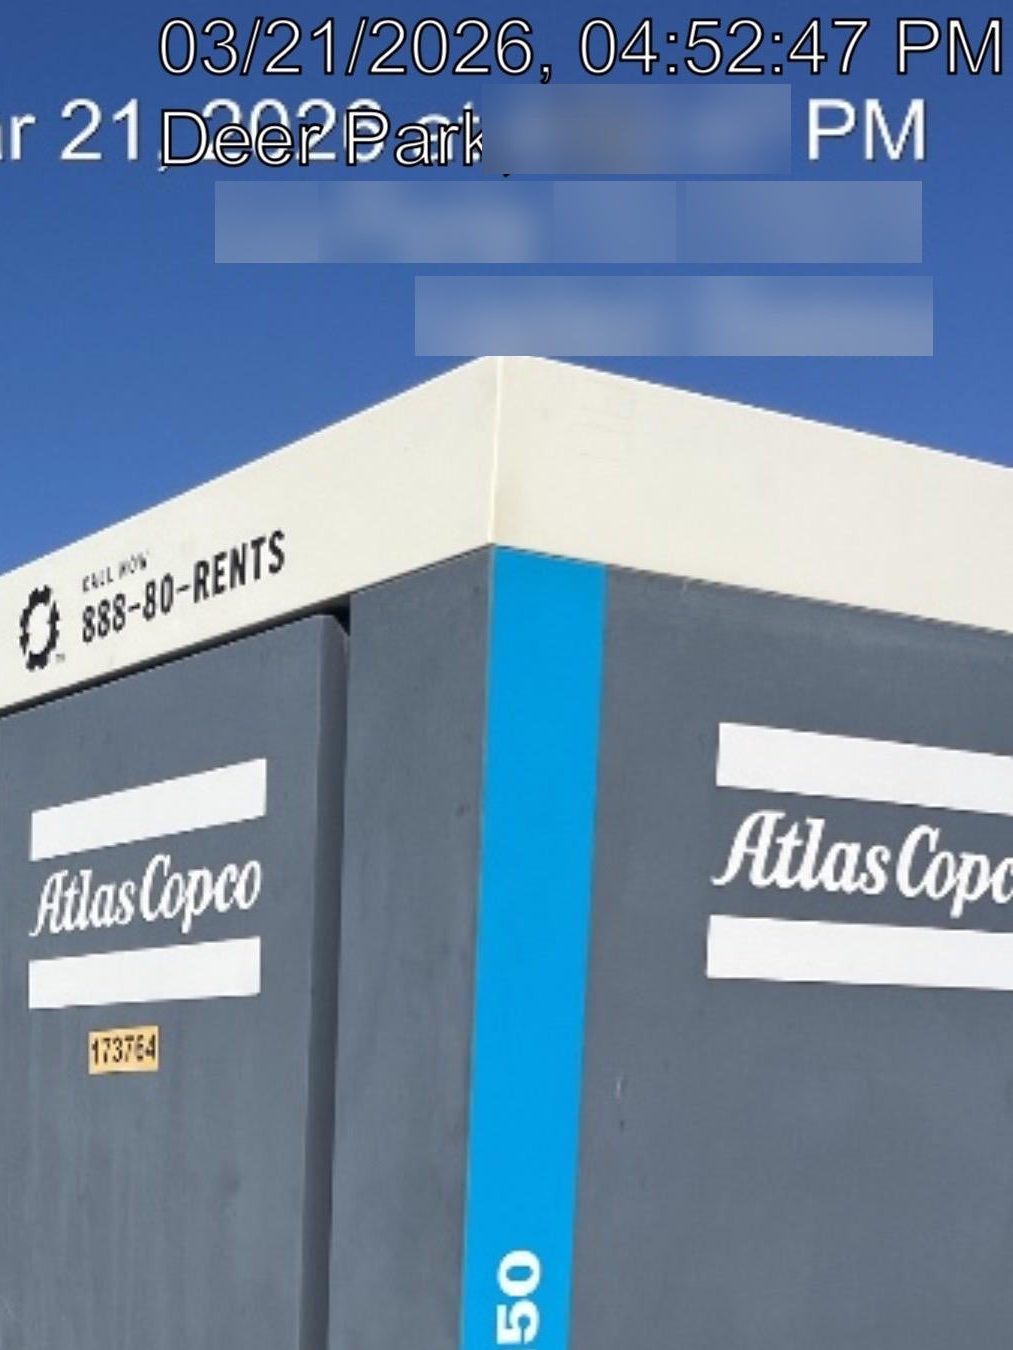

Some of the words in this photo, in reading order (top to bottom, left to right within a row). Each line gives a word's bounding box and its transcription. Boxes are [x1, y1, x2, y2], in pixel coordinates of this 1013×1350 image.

[81, 529, 286, 643] 888-80-RENTS
[82, 566, 114, 593] CALL
[712, 809, 891, 895] Atlas
[29, 868, 136, 937] Atlas
[139, 854, 262, 935] Copco
